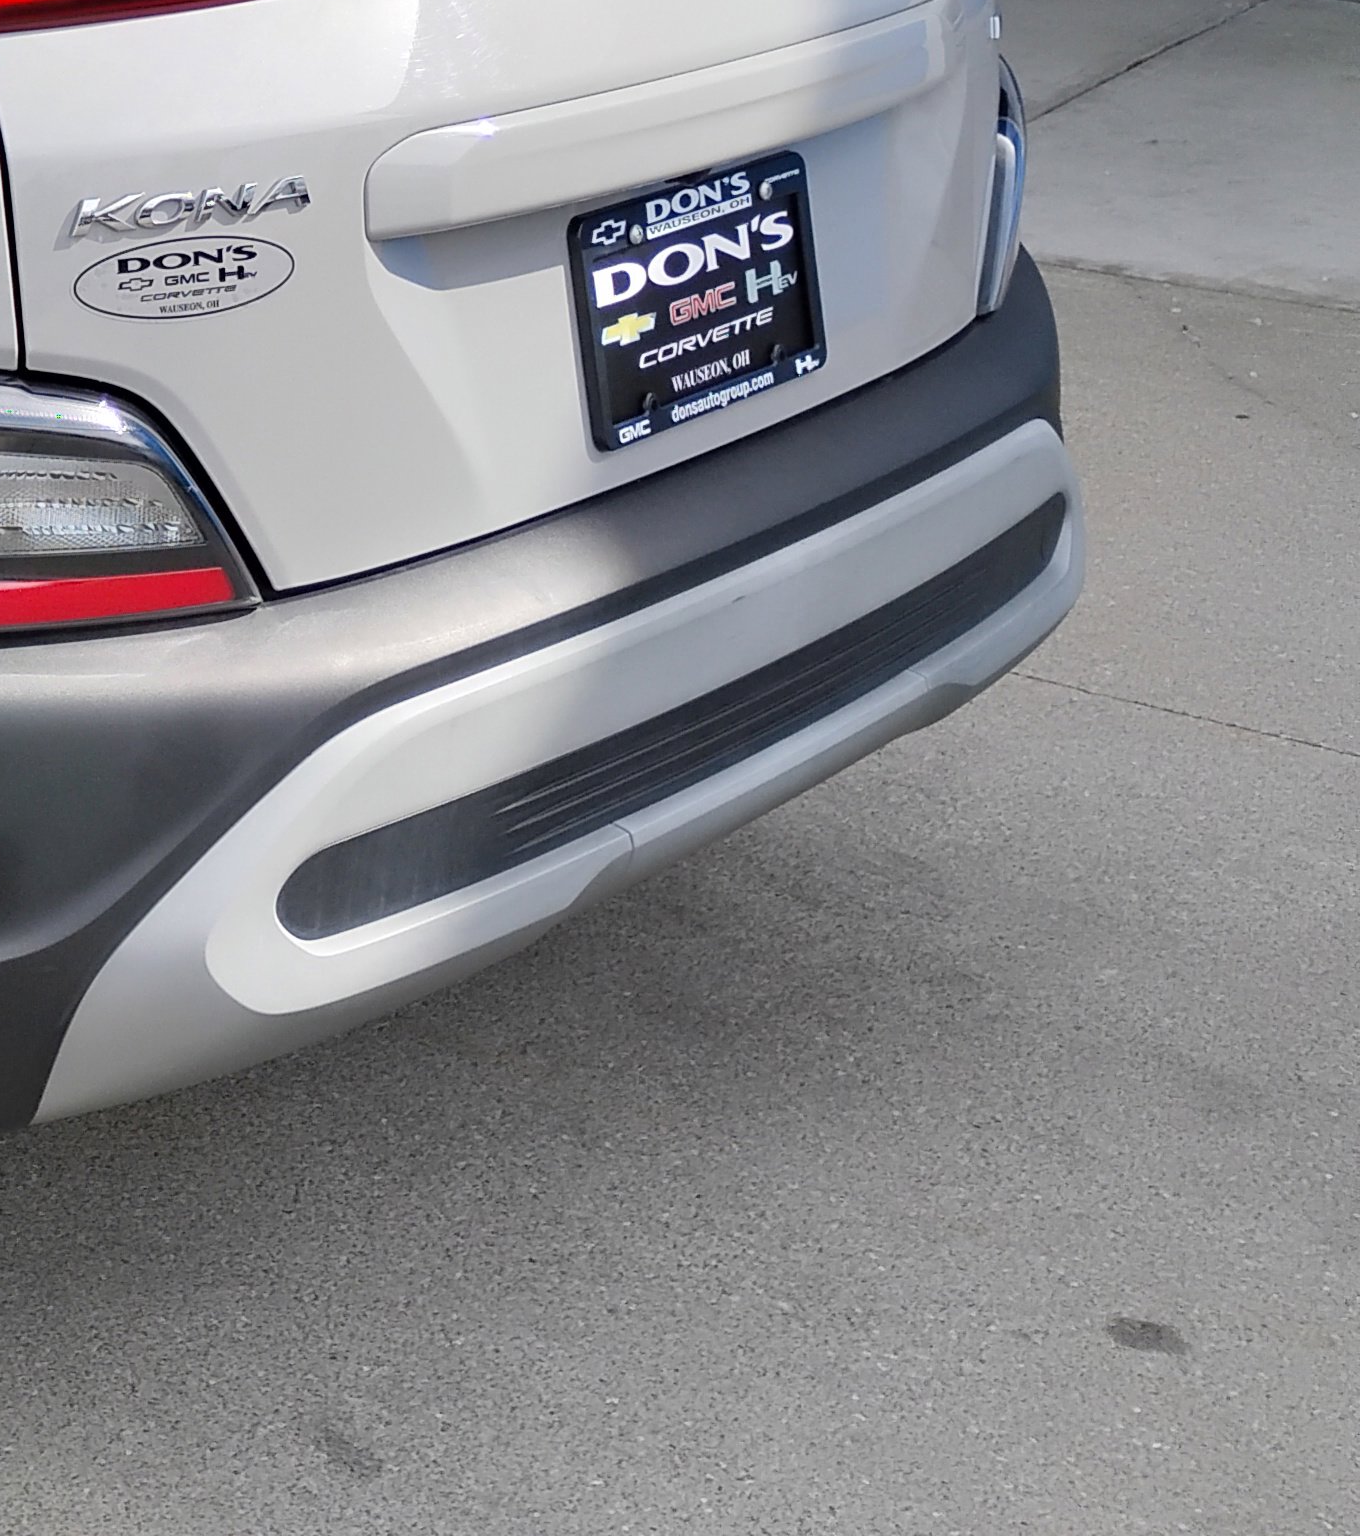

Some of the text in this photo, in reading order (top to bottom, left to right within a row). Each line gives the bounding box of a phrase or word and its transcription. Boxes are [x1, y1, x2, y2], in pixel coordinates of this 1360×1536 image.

[66, 175, 311, 238] KONA
[645, 171, 751, 224] DON'S
[648, 195, 751, 235] WAUSEON, OH
[116, 245, 258, 275] DON'S
[164, 271, 210, 287] GMC
[592, 211, 795, 309] DON'S
[140, 284, 237, 302] CORVETTE
[206, 299, 220, 309] OH
[668, 281, 737, 326] GMC
[638, 306, 774, 369] CORVETTE
[671, 349, 751, 392] WAUSEON, OH
[671, 371, 774, 422] donsautogroup.com
[618, 419, 652, 444] GMC
